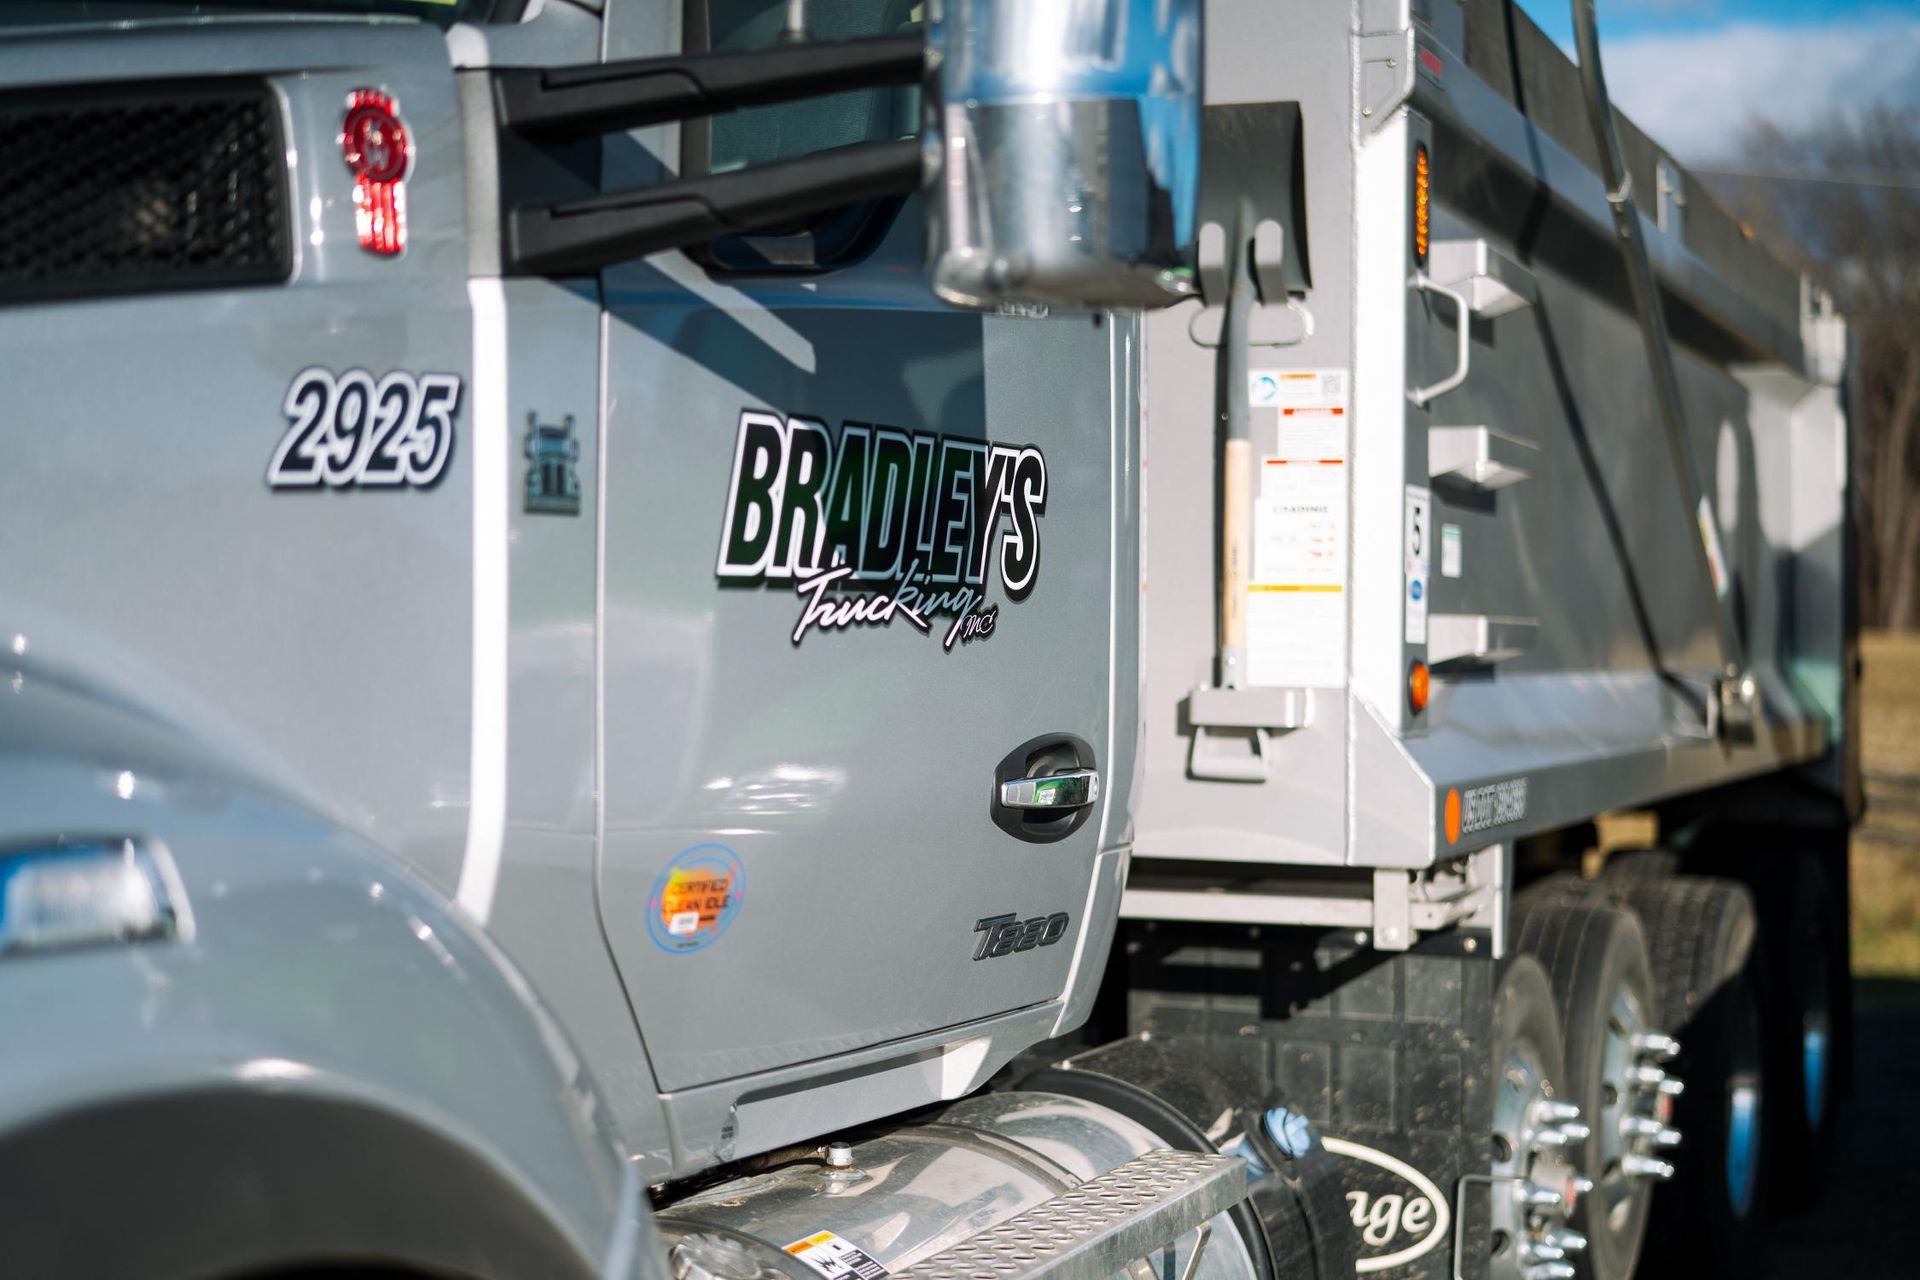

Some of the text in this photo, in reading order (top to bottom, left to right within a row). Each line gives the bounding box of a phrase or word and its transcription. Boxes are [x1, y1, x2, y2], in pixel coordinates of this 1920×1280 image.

[266, 367, 461, 488] 2925
[715, 410, 1047, 596] BRADLEY'S
[793, 558, 983, 647] Trucking
[972, 911, 1070, 961] T880
